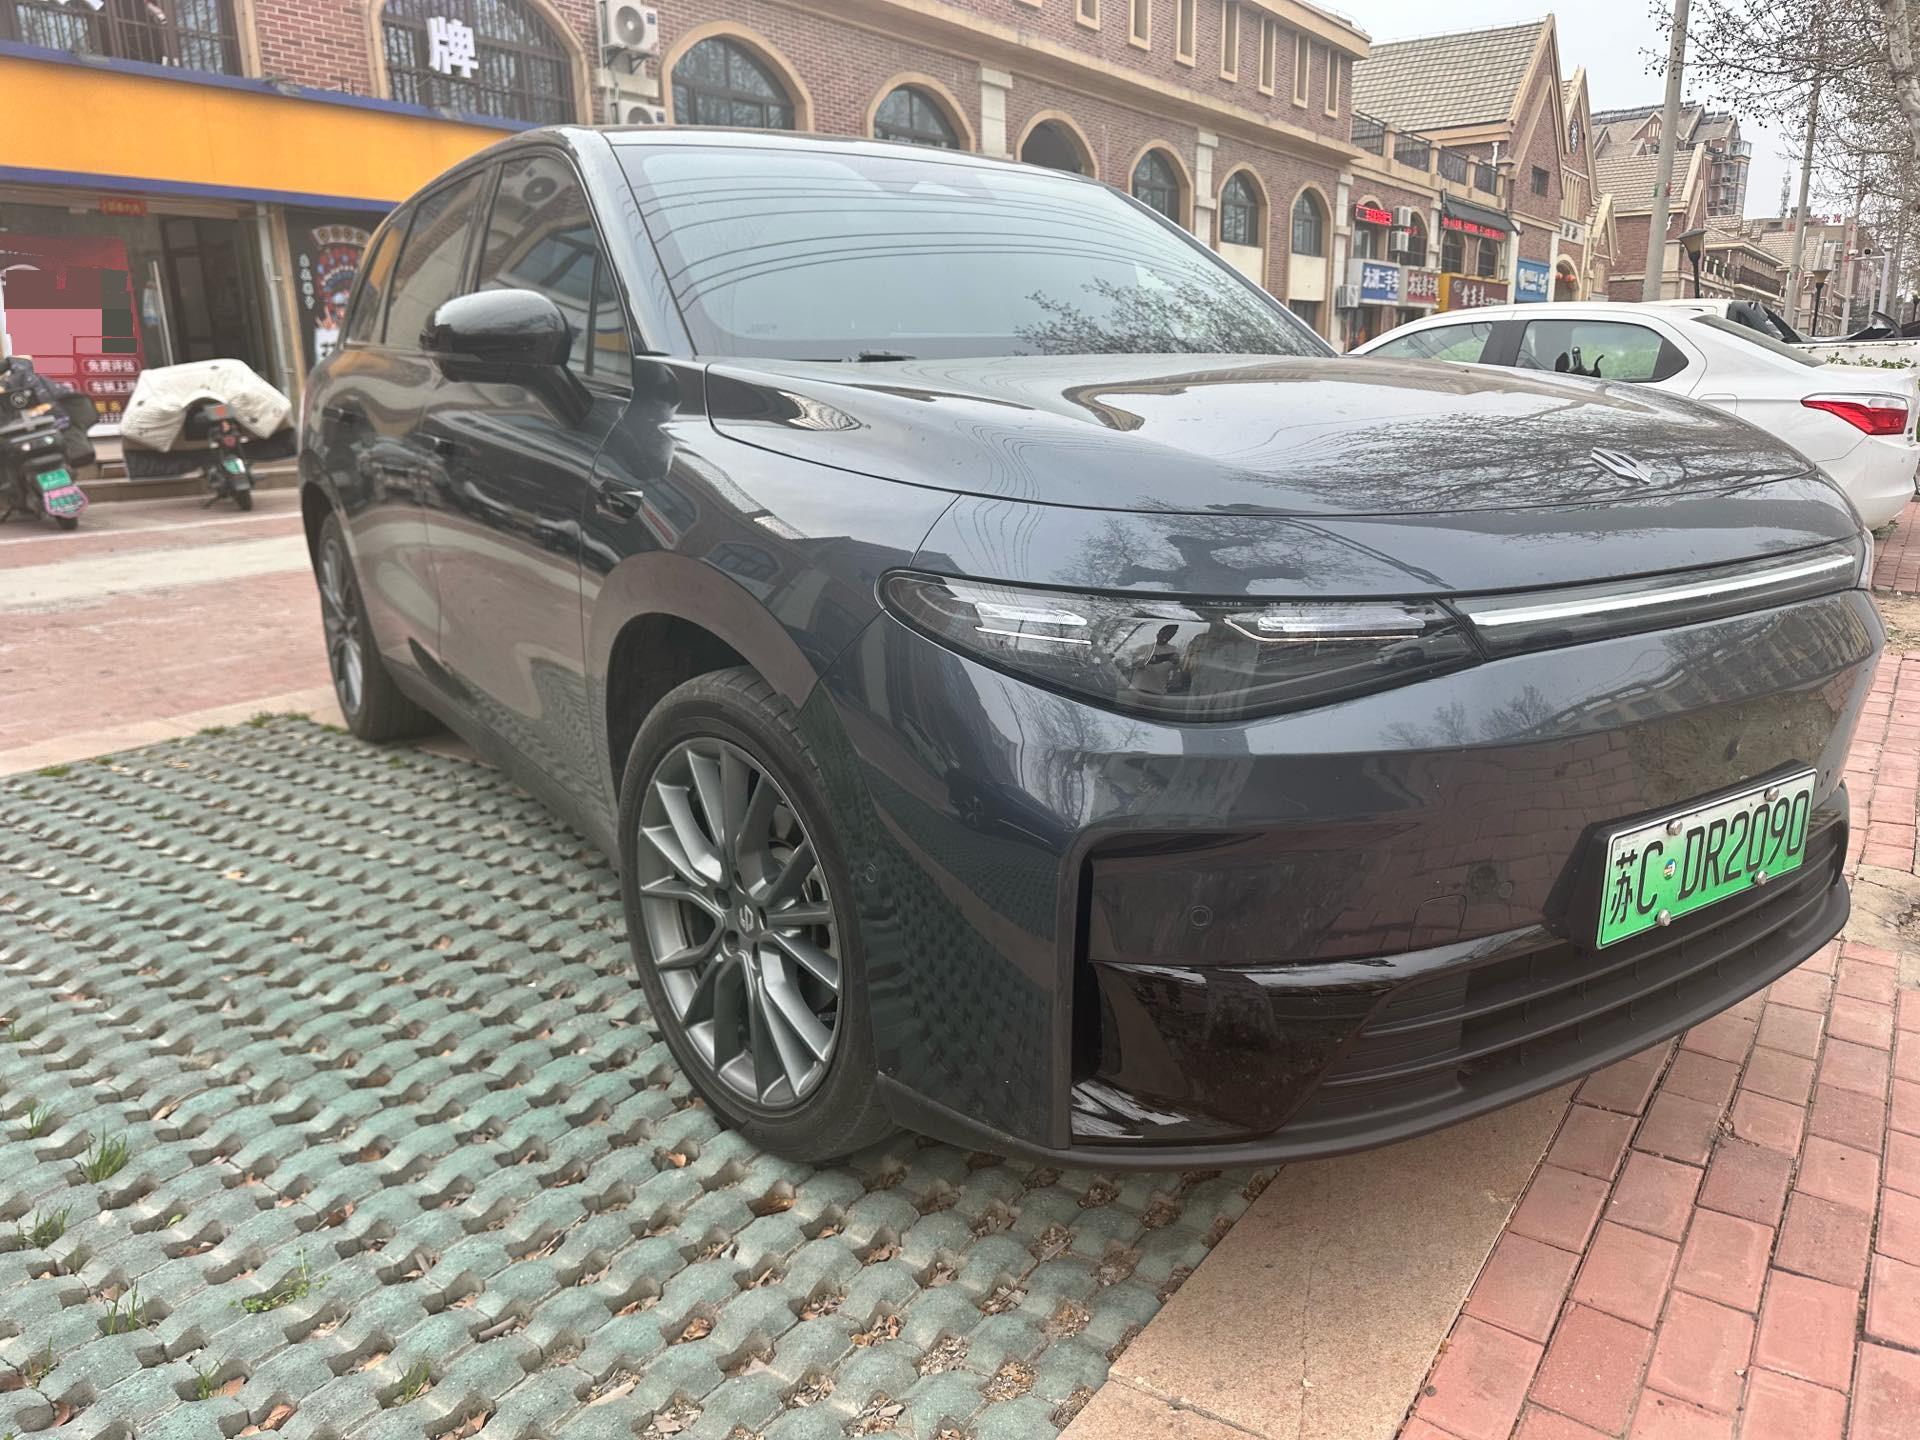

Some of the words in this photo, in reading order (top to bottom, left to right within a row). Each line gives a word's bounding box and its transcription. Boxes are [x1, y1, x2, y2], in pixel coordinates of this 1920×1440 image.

[426, 16, 479, 78] 牌
[87, 359, 135, 373] 免费评估
[1677, 789, 1810, 901] DR2090
